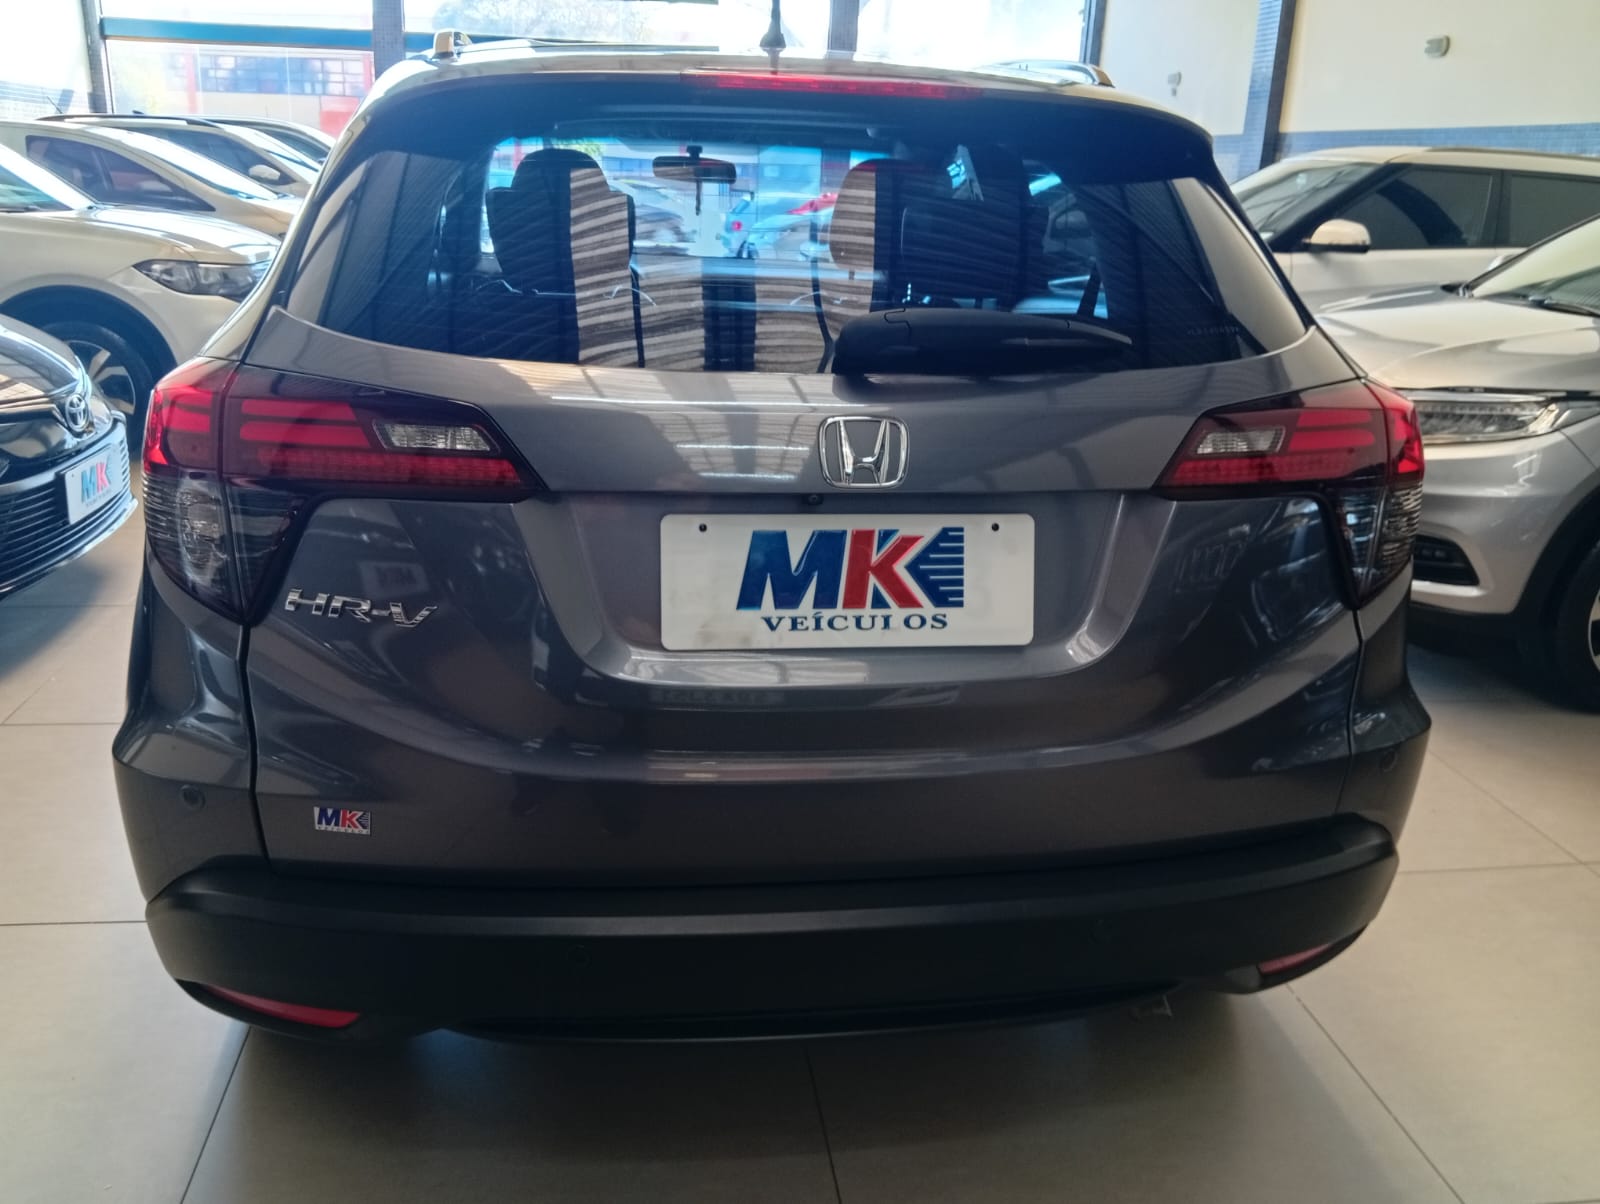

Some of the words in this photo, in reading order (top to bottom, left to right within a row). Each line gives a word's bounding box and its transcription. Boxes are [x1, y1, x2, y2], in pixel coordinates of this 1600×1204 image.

[81, 462, 109, 503] MK
[736, 527, 924, 610] MK
[285, 589, 437, 628] HR-V
[317, 807, 359, 829] MK
